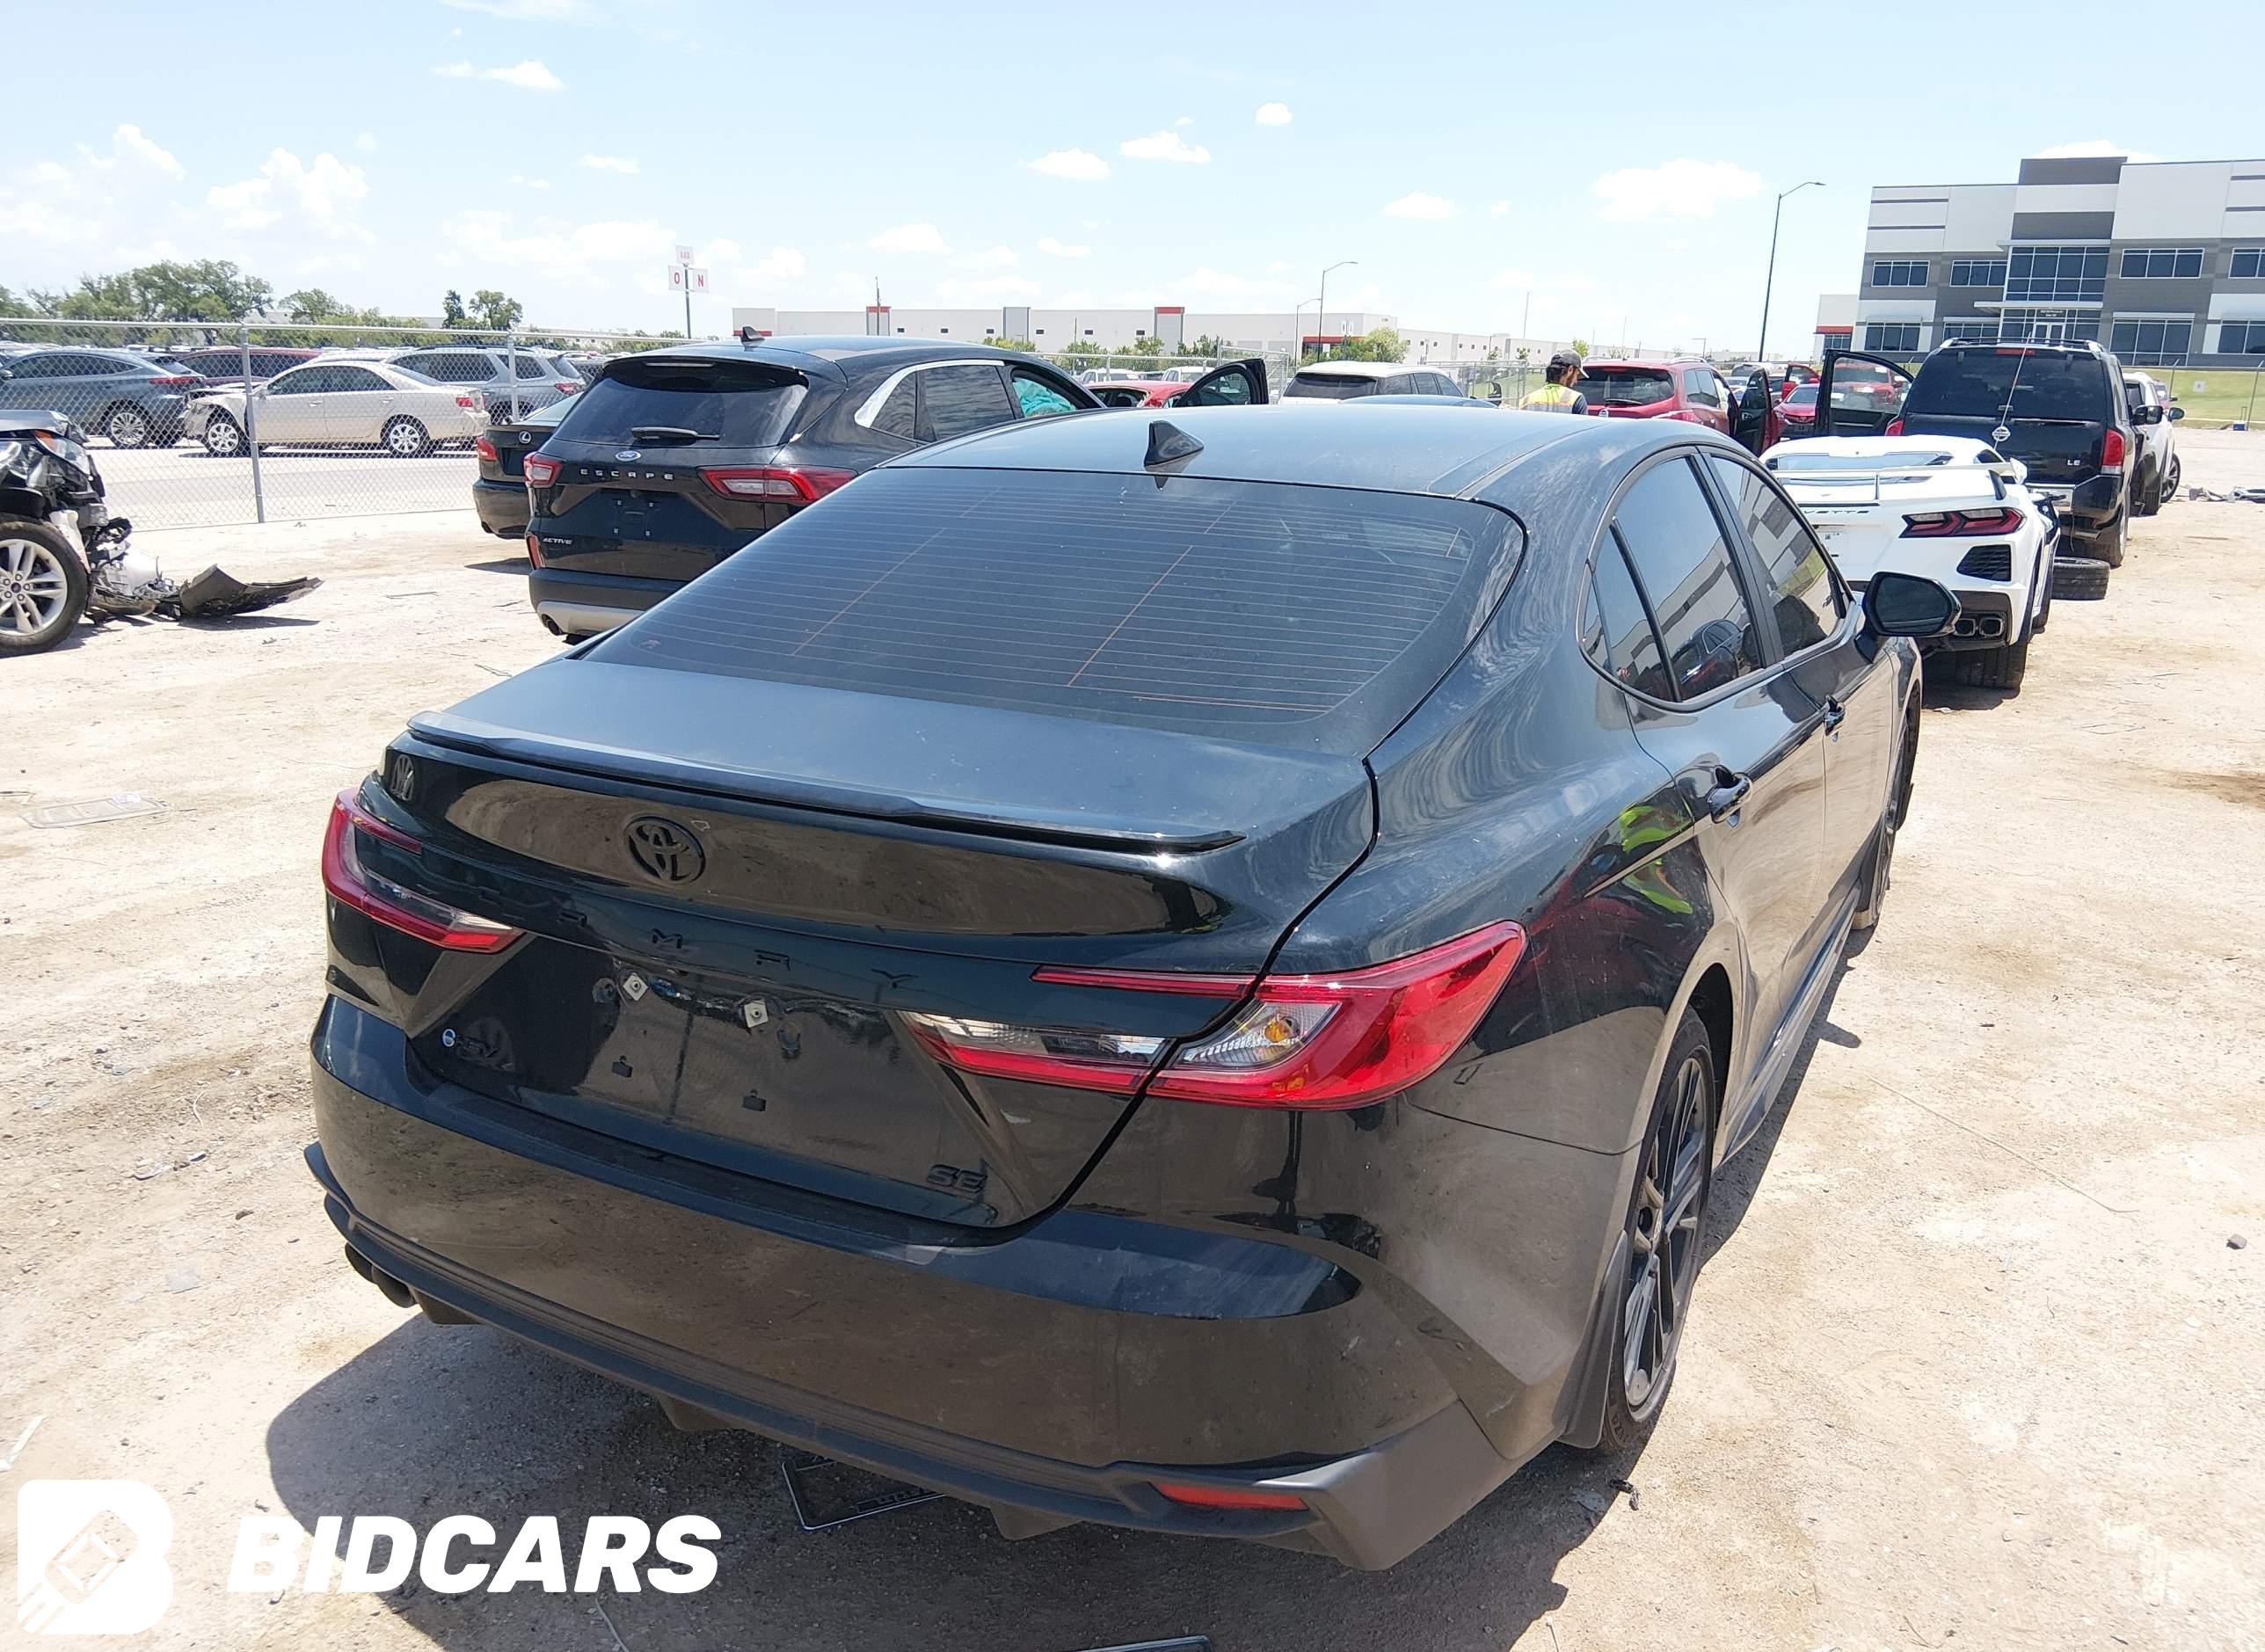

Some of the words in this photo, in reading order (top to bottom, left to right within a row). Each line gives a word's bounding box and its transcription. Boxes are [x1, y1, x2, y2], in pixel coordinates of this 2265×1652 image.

[697, 274, 704, 287] N
[580, 469, 674, 480] ESCAPE
[926, 1164, 987, 1194] SE
